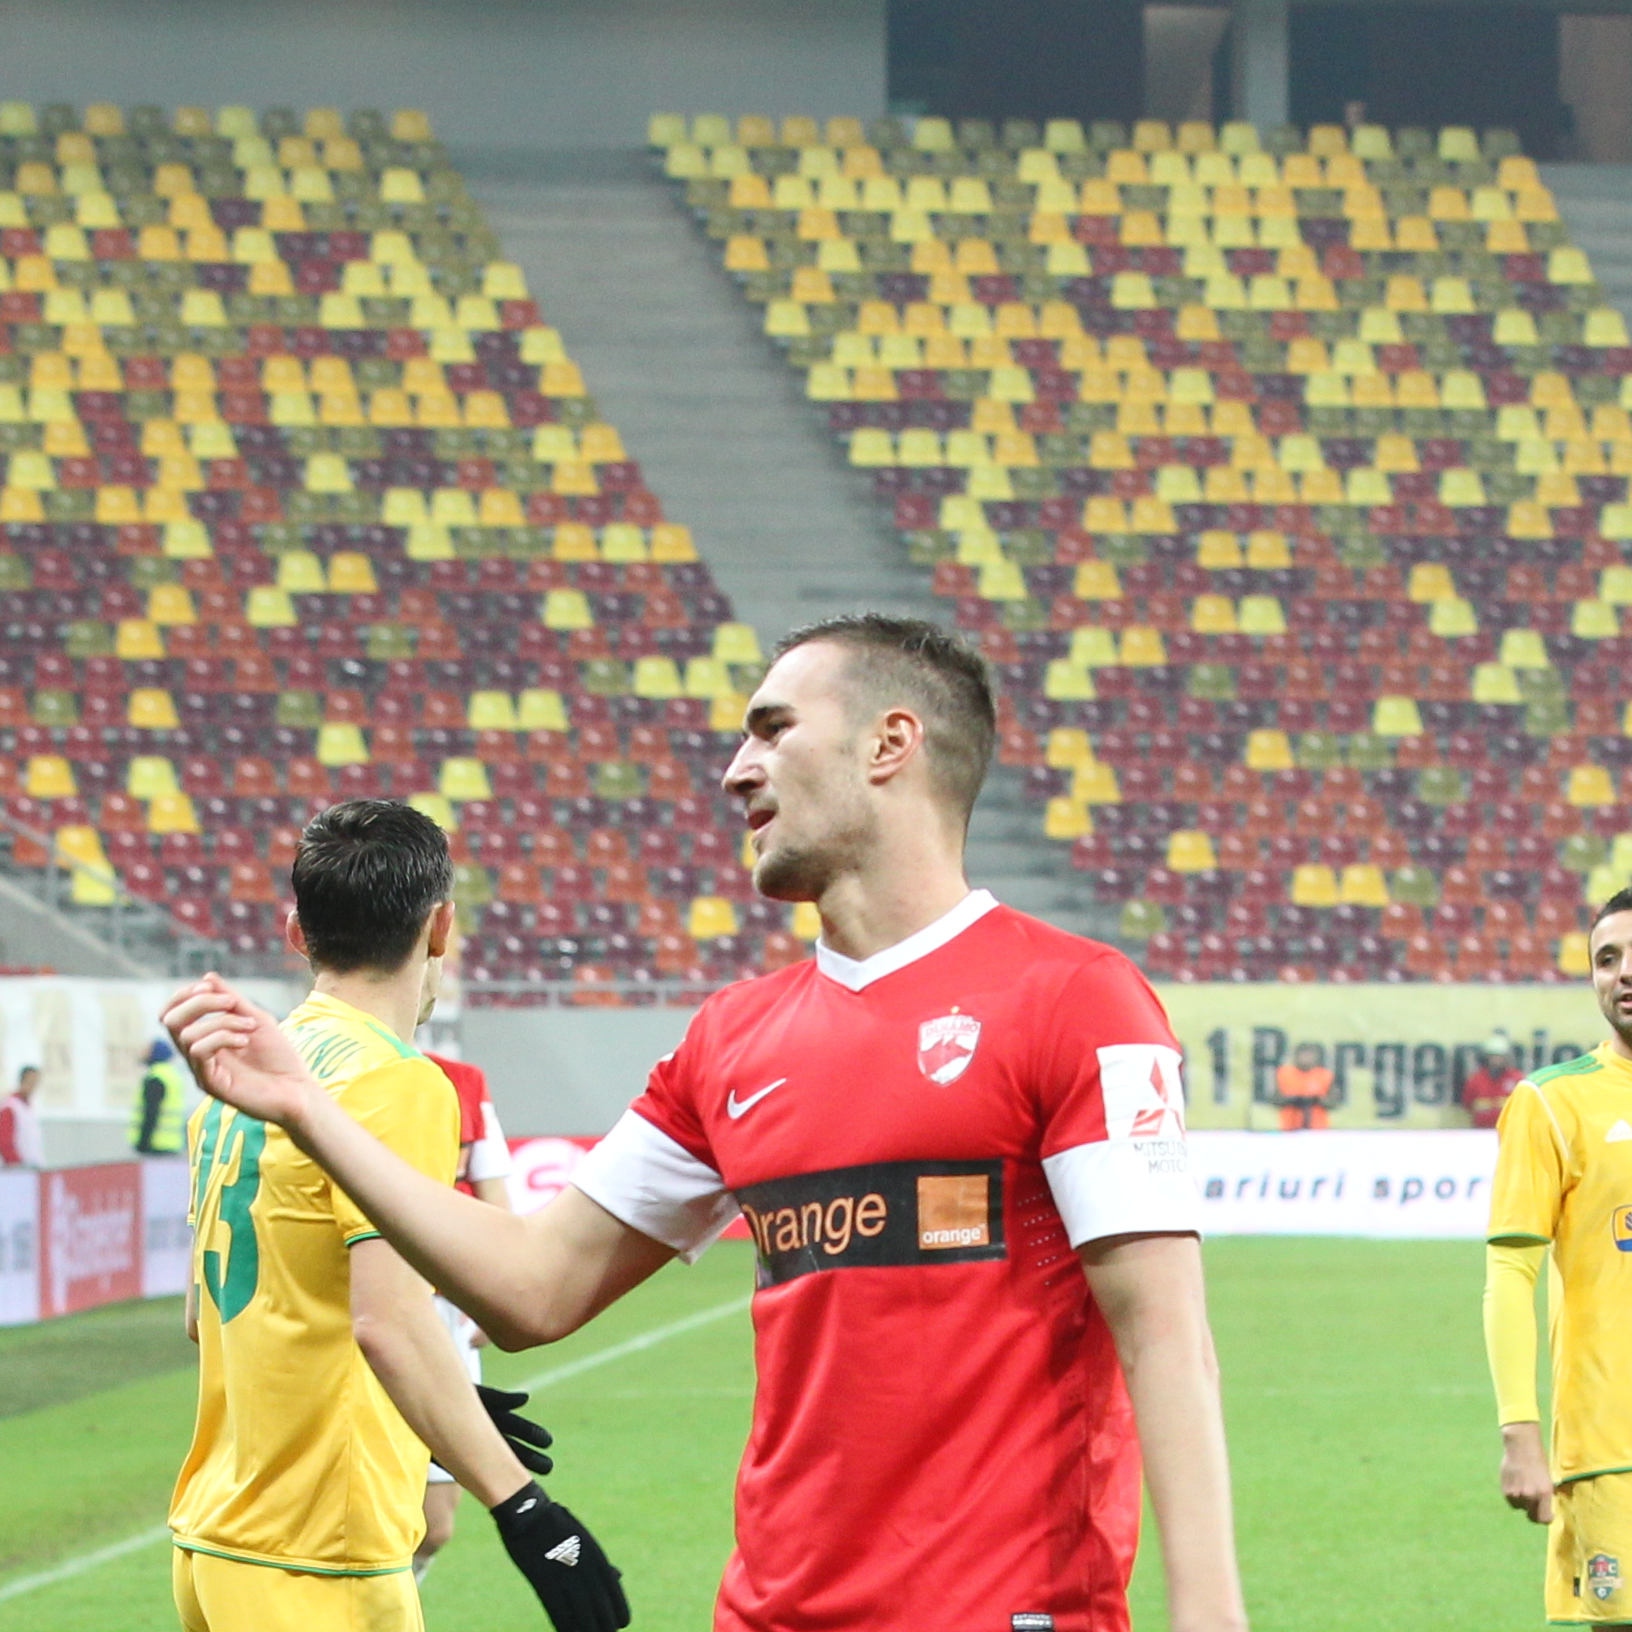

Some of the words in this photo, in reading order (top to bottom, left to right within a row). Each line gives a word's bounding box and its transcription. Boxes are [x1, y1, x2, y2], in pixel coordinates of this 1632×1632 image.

[1205, 1170, 1345, 1201] ariuri
[1373, 1175, 1482, 1203] spor
[922, 1227, 982, 1246] orange
